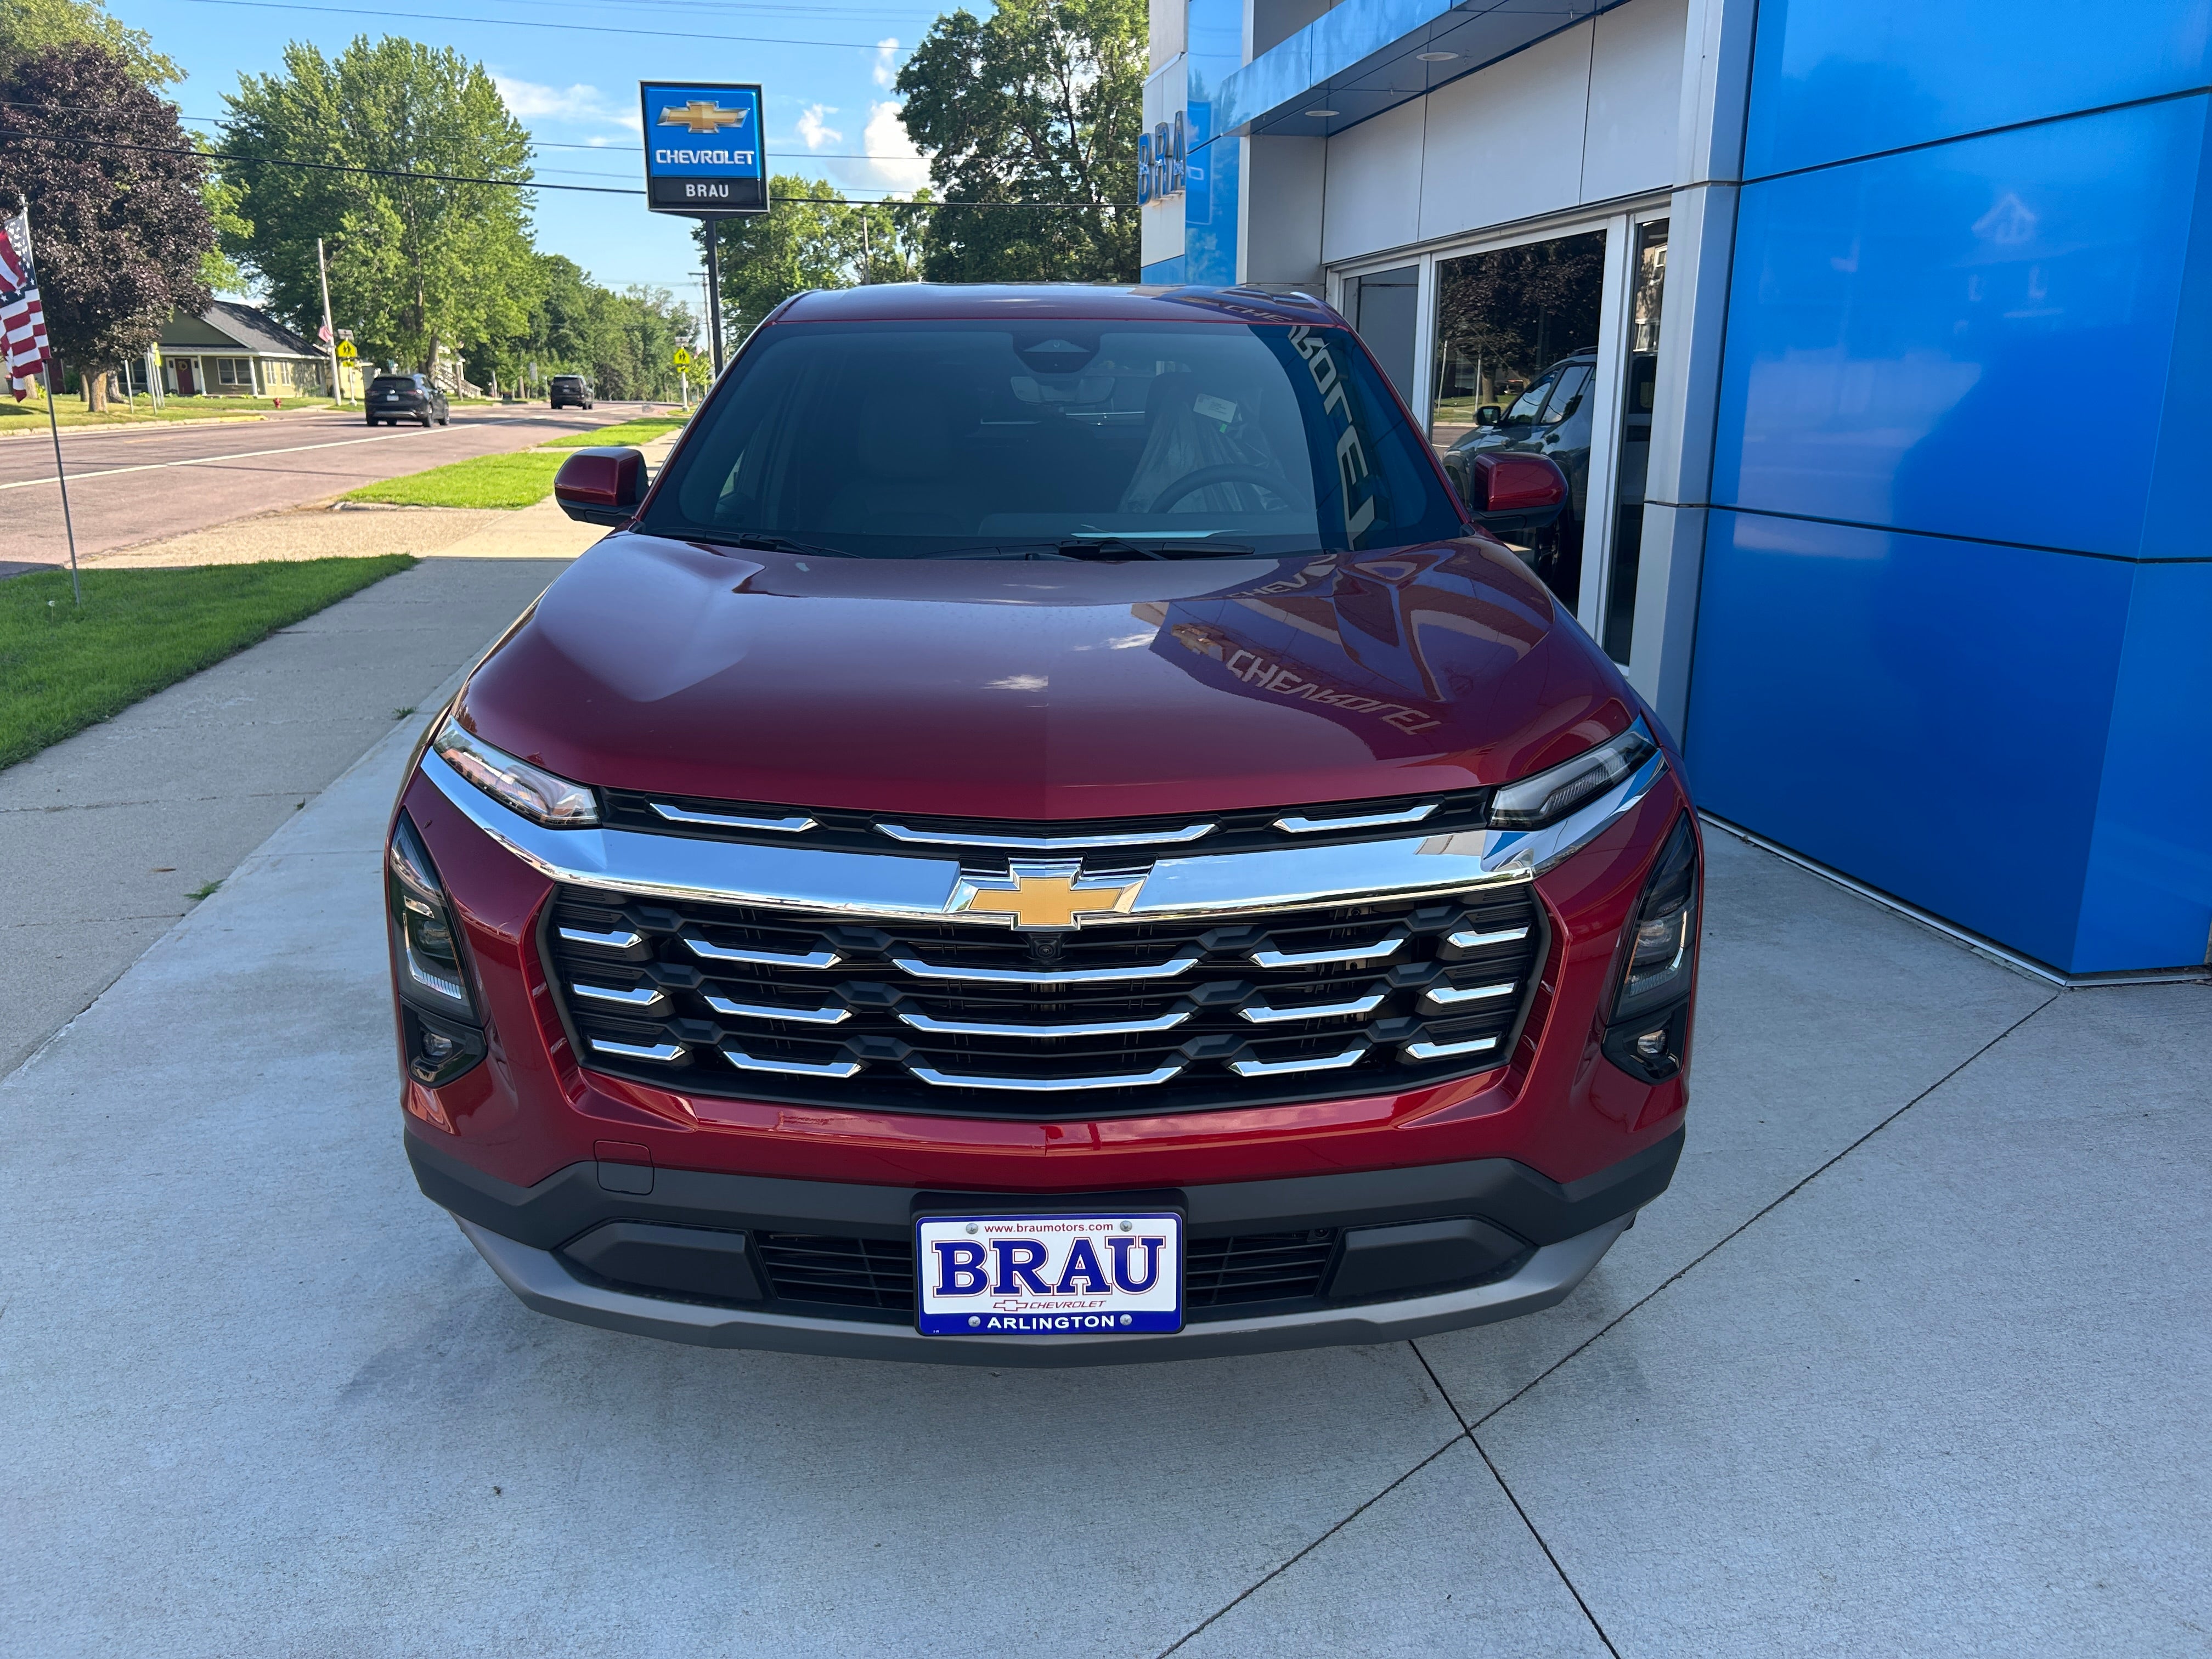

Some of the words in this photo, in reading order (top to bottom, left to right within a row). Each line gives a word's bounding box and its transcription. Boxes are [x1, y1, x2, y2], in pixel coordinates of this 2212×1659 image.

[655, 149, 755, 165] CHEVROLET
[685, 184, 730, 198] BRAU
[984, 1223, 1114, 1234] www.braumotors.com
[931, 1235, 1166, 1298] BRAU
[1029, 1300, 1107, 1310] CHEVROLET
[987, 1315, 1114, 1330] ARLINGTON
